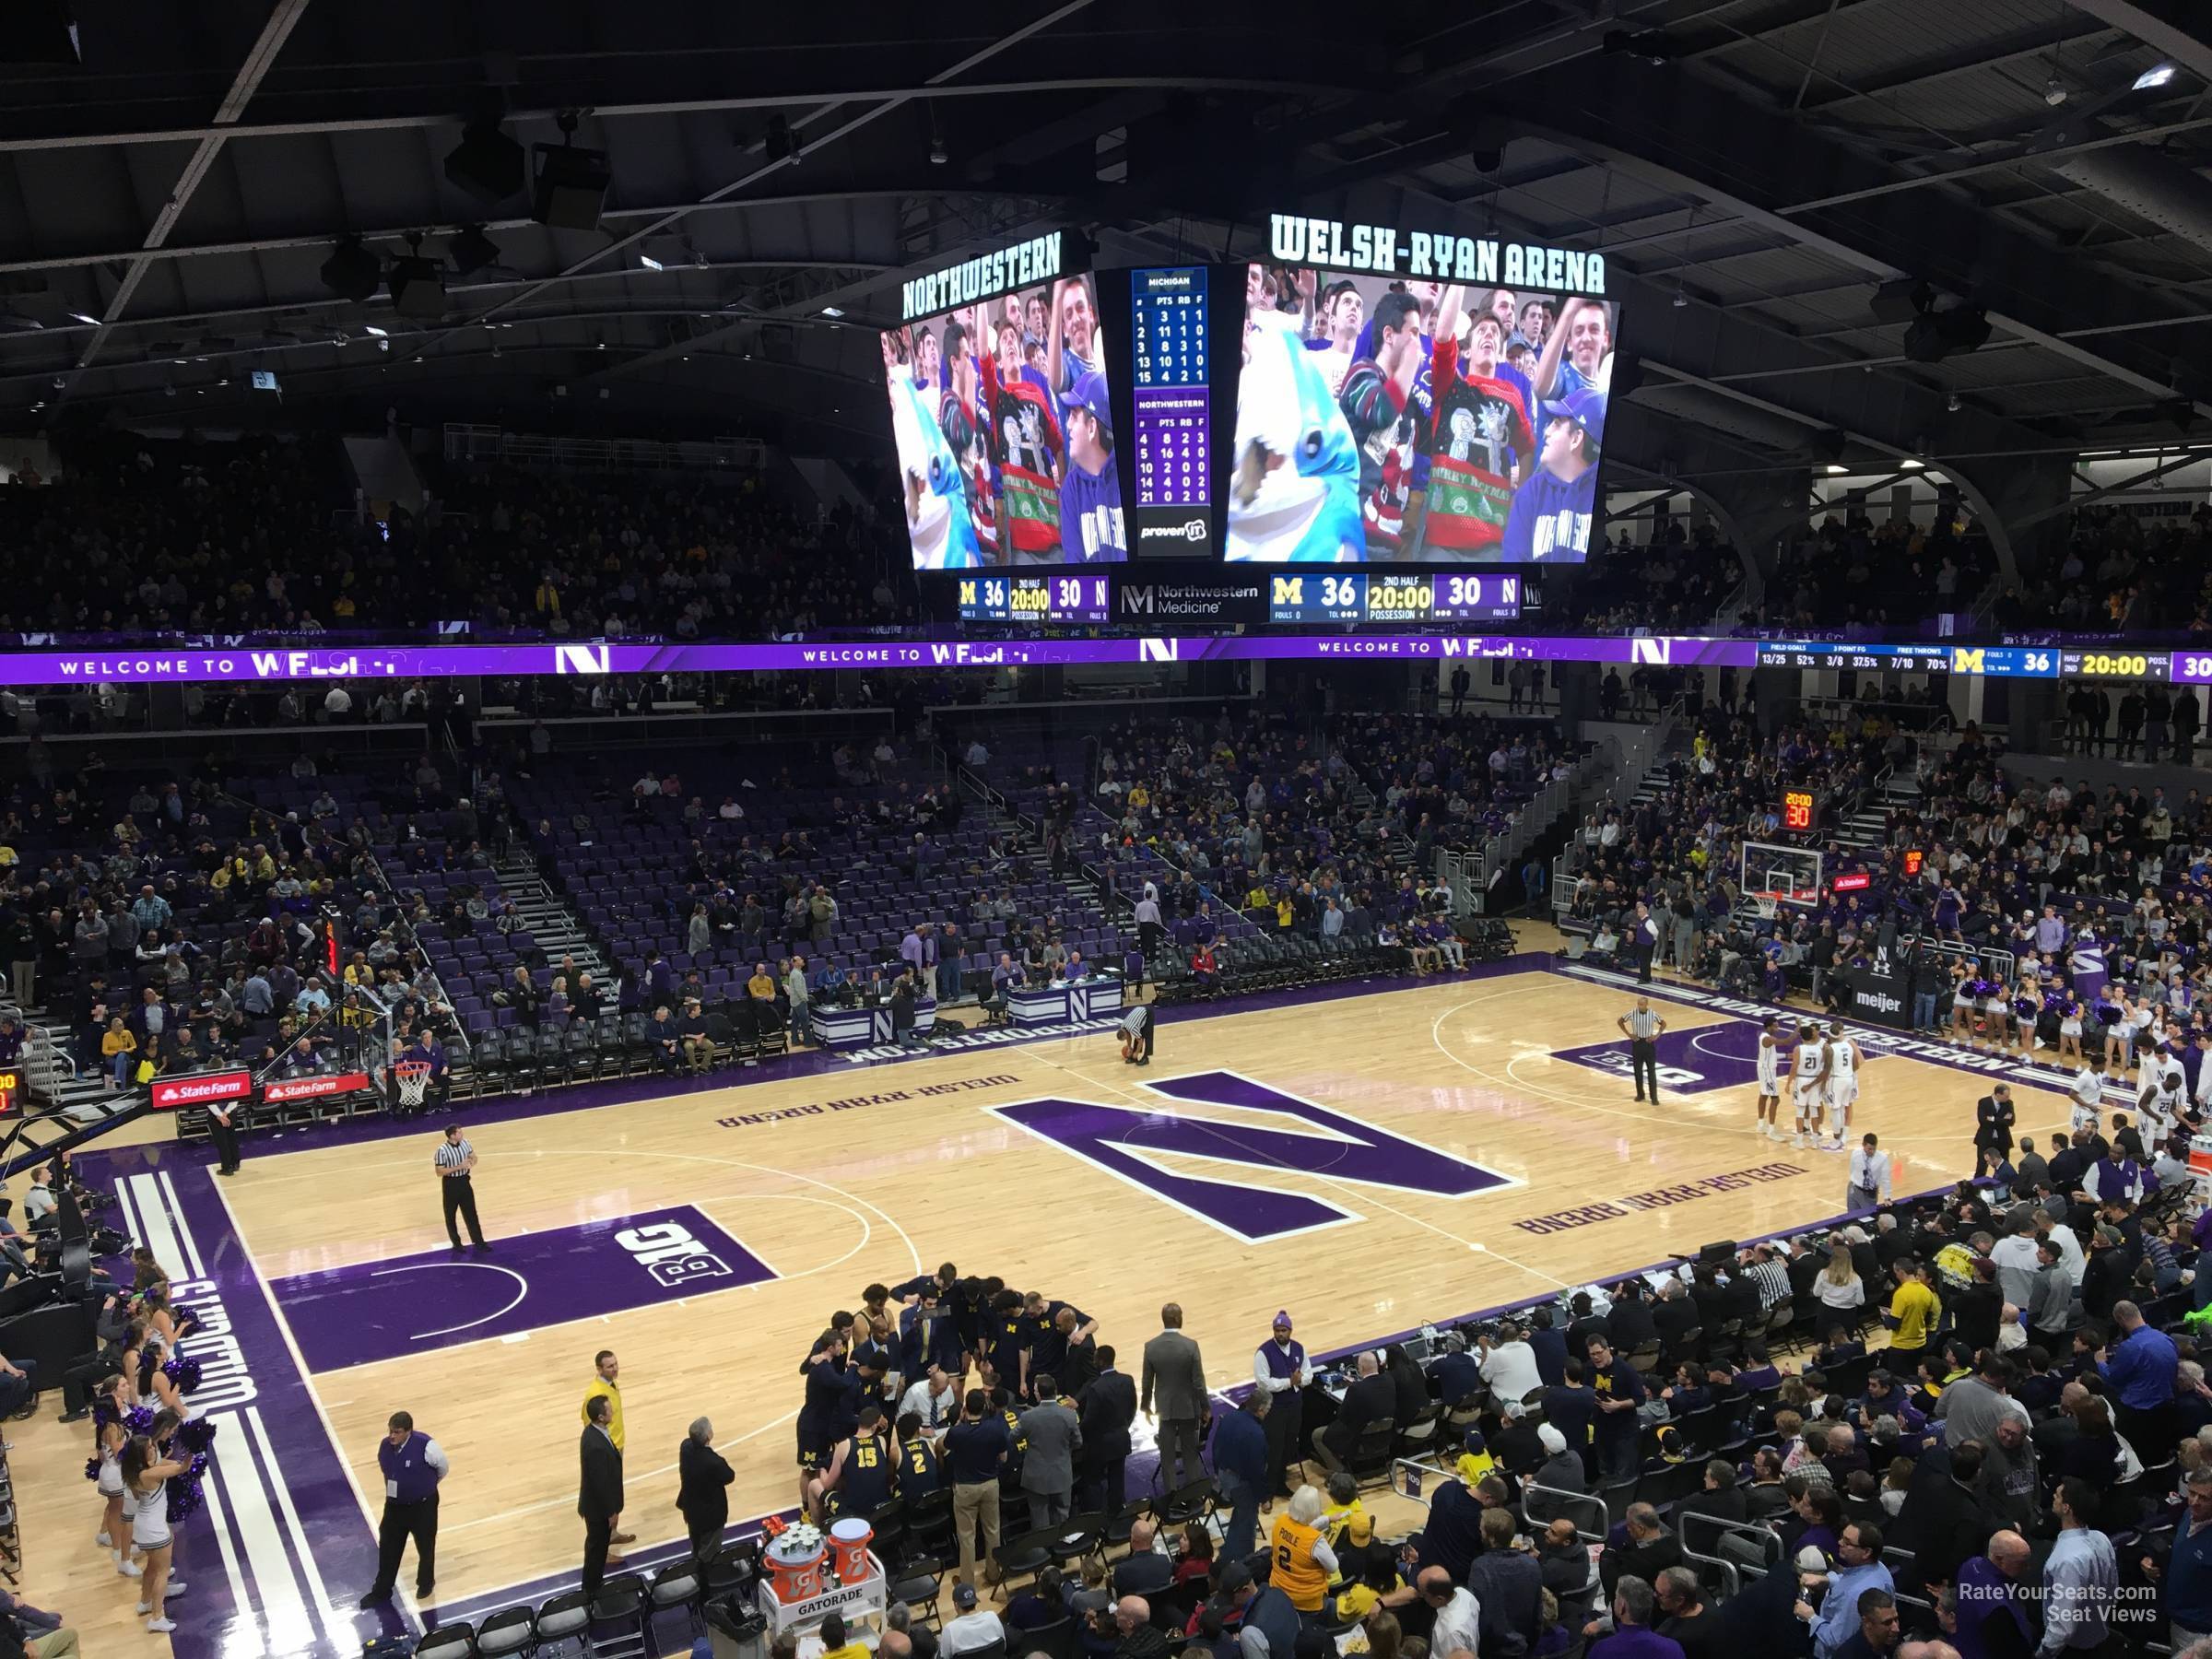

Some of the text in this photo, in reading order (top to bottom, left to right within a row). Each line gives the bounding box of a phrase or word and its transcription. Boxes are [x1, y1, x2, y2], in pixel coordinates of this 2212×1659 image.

[1271, 214, 1606, 293] WELSH-RYAN ARENA
[903, 231, 1061, 320] NORTHWESTERN
[1148, 277, 1190, 286] MICHIGAN
[1157, 297, 1172, 305] PTS
[1178, 296, 1191, 304] RB
[1196, 295, 1202, 303] F
[1136, 310, 1202, 323] 1 3 1 1
[1137, 324, 1203, 338] 2 11 1 0
[1137, 340, 1202, 353] 3 8 3 1
[1138, 355, 1204, 368] 13 10 1 0
[1138, 370, 1203, 382] 15 4 2 1
[1139, 400, 1204, 409] NORTHWESTERN
[1159, 418, 1174, 427] PTS
[1180, 418, 1193, 427] RB
[1140, 432, 1204, 444] 4 8 2 3
[1141, 447, 1205, 459] 5 16 4 0
[1141, 462, 1205, 473] 10 2 0 0
[1141, 477, 1205, 488] 14 4 0 2
[1141, 490, 1206, 502] 21 0 2 0
[1141, 527, 1190, 538] proven
[1383, 577, 1418, 586] 2ND HALF
[960, 580, 1105, 610] M 36 20:00 30 N
[1159, 585, 1258, 598] Northwestern
[1273, 577, 1303, 605] M
[1321, 577, 1356, 606] 36
[1370, 586, 1431, 609] 20:00
[1448, 577, 1480, 605] 30
[1502, 579, 1516, 603] N
[1159, 601, 1218, 614] Medicine
[1275, 611, 1292, 619] FOULS
[1296, 611, 1300, 619] 0
[1371, 610, 1416, 620] POSSESSION
[1139, 638, 1178, 662] N
[1319, 642, 1430, 653] WELCOME TO
[1631, 639, 1670, 664] N
[555, 646, 609, 674] N
[804, 650, 920, 662] WELCOME TO
[1762, 654, 1947, 670] 13/25 52% 3/8 37.5% 7/10 70%
[1954, 649, 2212, 677] M 36 20:00 30
[2065, 654, 2169, 665] HALF POSS.
[60, 658, 233, 677] WELCOME TO
[1786, 793, 1812, 806] 20:00
[1788, 806, 1810, 828] 30
[1909, 861, 1918, 873] 30
[1877, 946, 1888, 961] N
[1070, 989, 1088, 1022] N
[1857, 992, 1901, 1013] meijer
[874, 1010, 893, 1043] N
[1805, 1057, 1817, 1069] 21
[1842, 1053, 1849, 1066] 5
[717, 1075, 1022, 1129] WELSH-RYAN ARENA
[2159, 1102, 2171, 1113] 23
[979, 1068, 1529, 1245] N
[1512, 1163, 1810, 1235] WELSH-RYAN ARENA
[1595, 1373, 1613, 1393] M
[856, 1447, 877, 1468] 15
[912, 1453, 926, 1475] 2
[1407, 1471, 1420, 1487] 109
[1279, 1527, 1300, 1547] POOLE
[849, 1548, 863, 1563] G
[1278, 1545, 1292, 1572] 2
[796, 1572, 810, 1587] G
[798, 1588, 863, 1616] GATORADE
